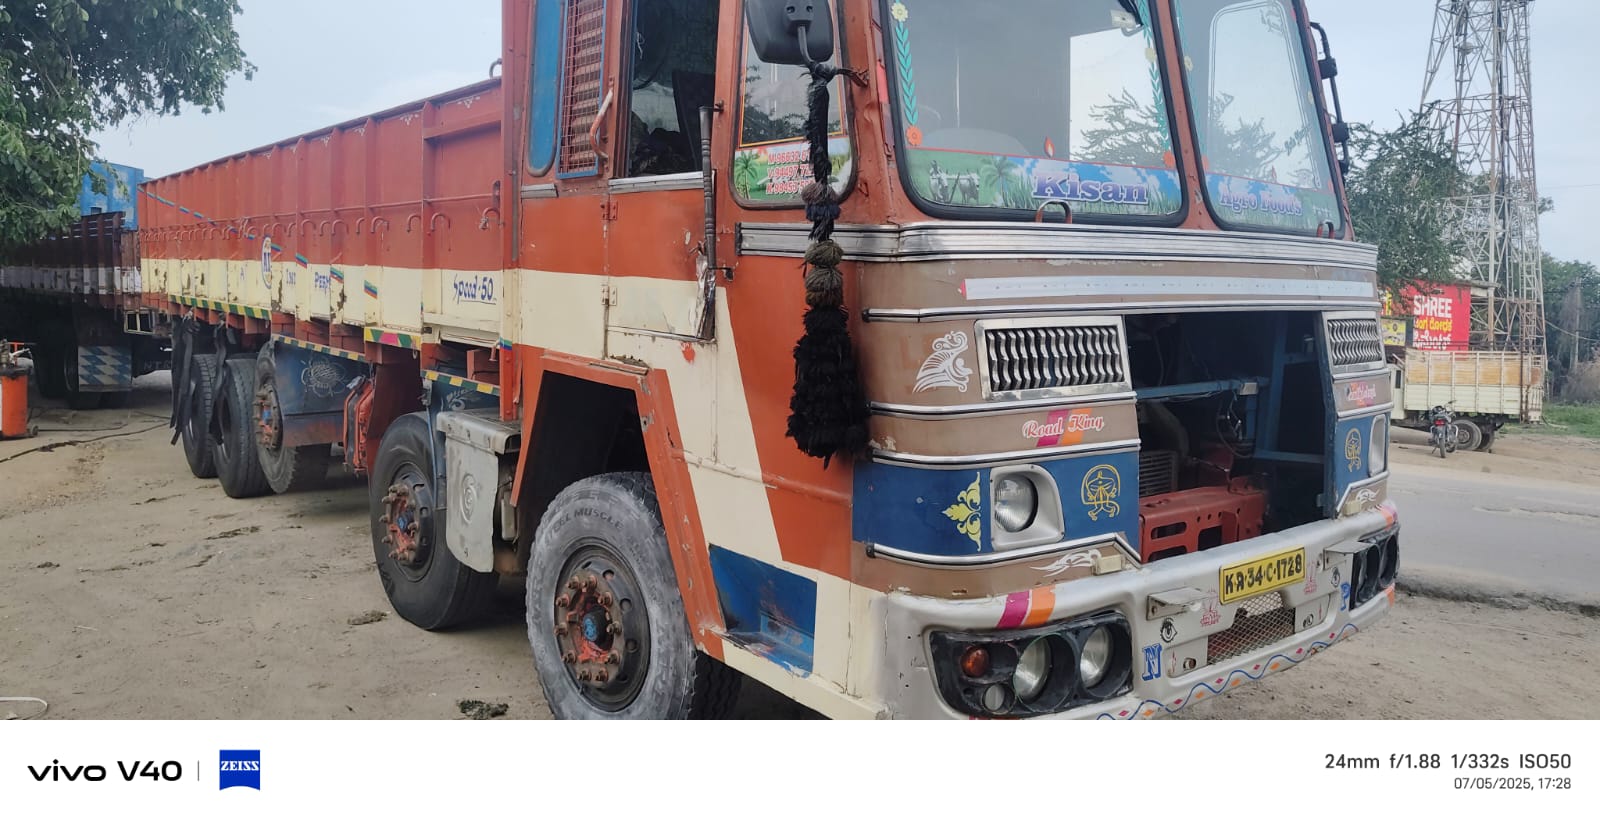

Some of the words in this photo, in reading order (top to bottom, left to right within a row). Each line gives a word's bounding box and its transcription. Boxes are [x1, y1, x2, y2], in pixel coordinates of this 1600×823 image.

[1032, 174, 1148, 204] Kisan
[1220, 190, 1258, 213] Agro
[1260, 190, 1302, 215] Foods
[1413, 295, 1452, 318] SHREE
[1022, 417, 1064, 438] Road
[1068, 414, 1105, 432] King
[574, 507, 624, 530] MUSCLE
[1142, 643, 1163, 681] N
